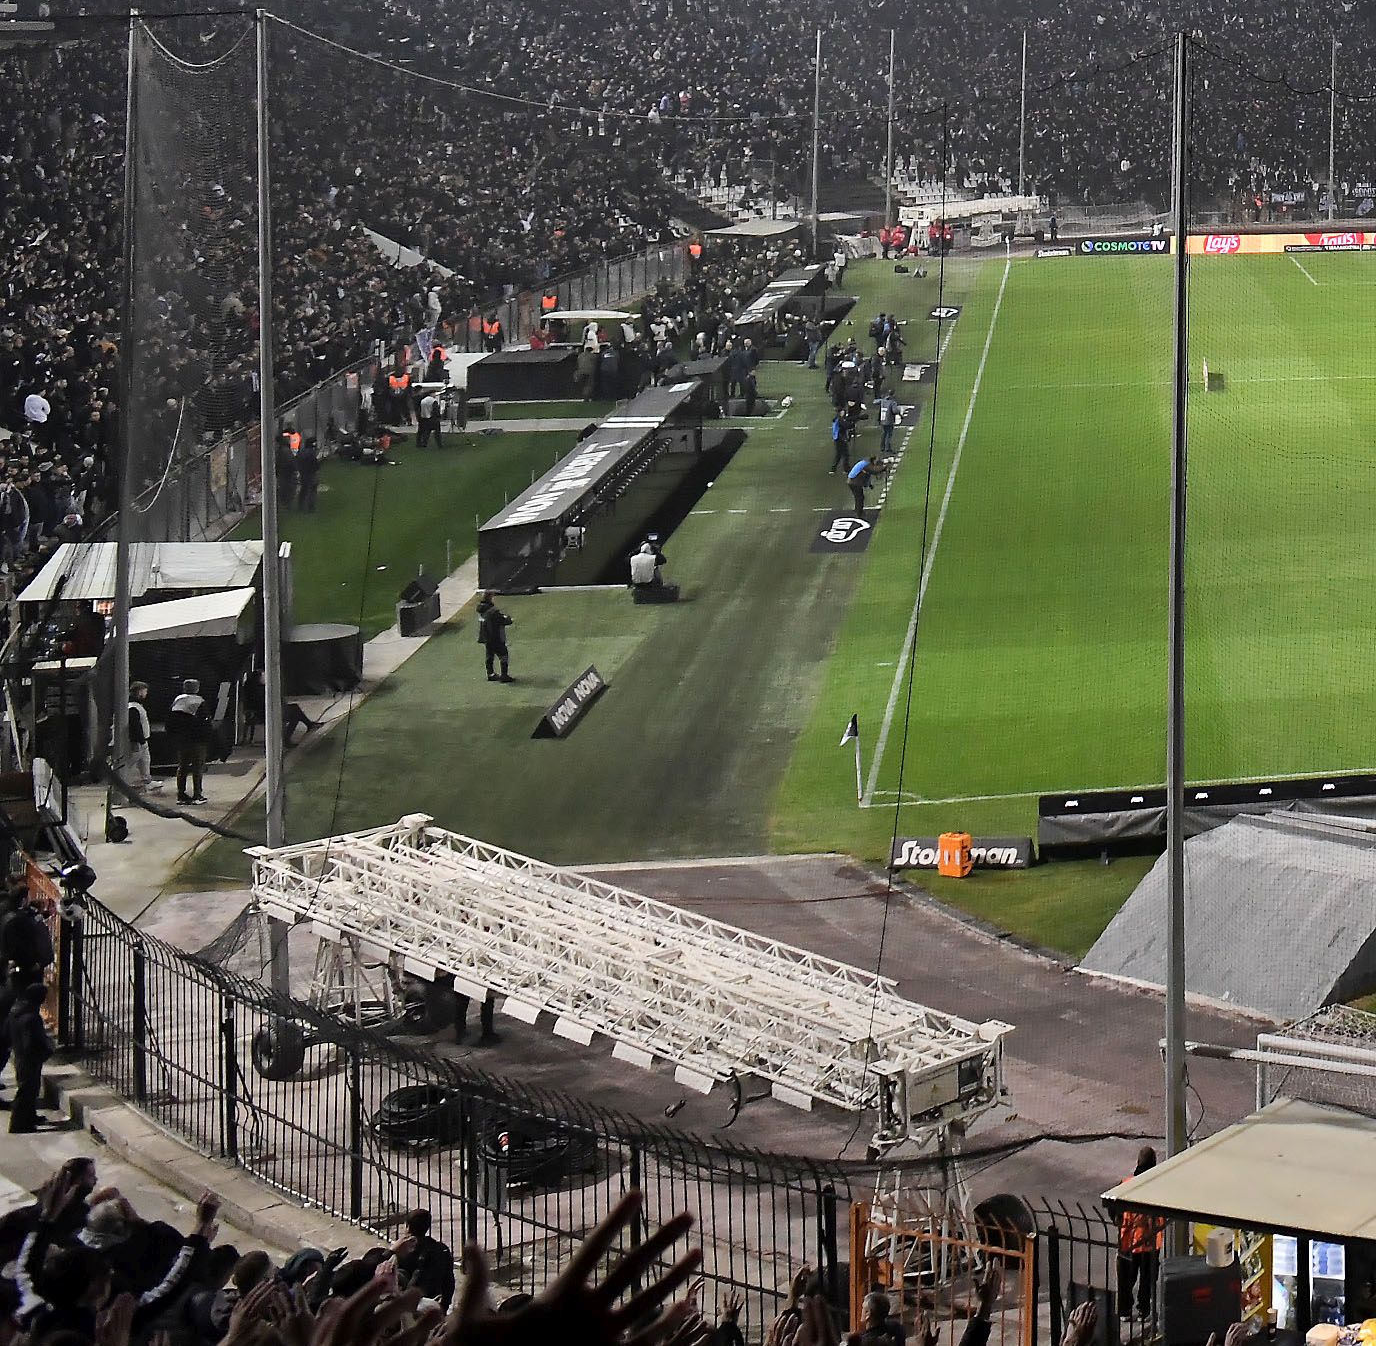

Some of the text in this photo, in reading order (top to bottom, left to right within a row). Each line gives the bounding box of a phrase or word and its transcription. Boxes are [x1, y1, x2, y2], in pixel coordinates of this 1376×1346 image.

[1094, 241, 1165, 252] COSMOTE TV
[551, 672, 601, 730] NOVA NOVA
